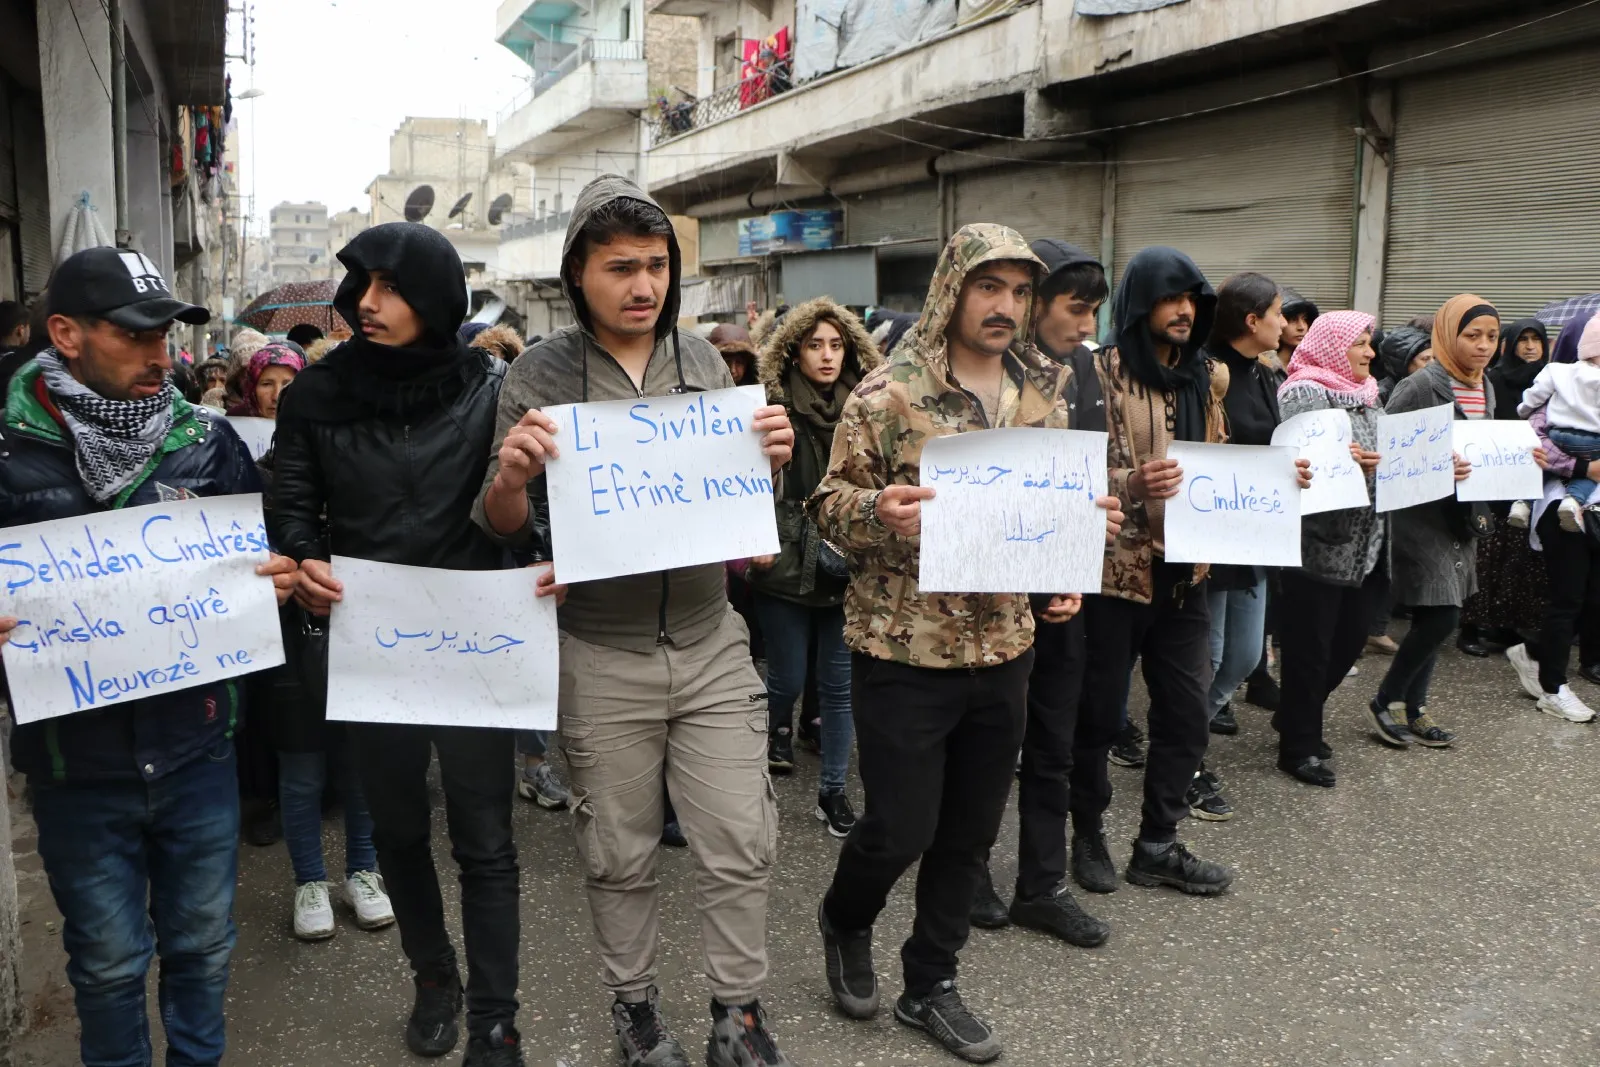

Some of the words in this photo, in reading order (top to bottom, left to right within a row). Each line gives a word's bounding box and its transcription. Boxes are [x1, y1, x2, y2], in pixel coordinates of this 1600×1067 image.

[573, 406, 600, 452] Li
[589, 463, 692, 516] Efrînê
[703, 467, 774, 500] nexin
[1188, 472, 1284, 514] Cindrêsê
[149, 587, 229, 650] agirê
[375, 625, 525, 655] جنديرس
[65, 651, 201, 709] Newrozê
[216, 649, 253, 669] ne
